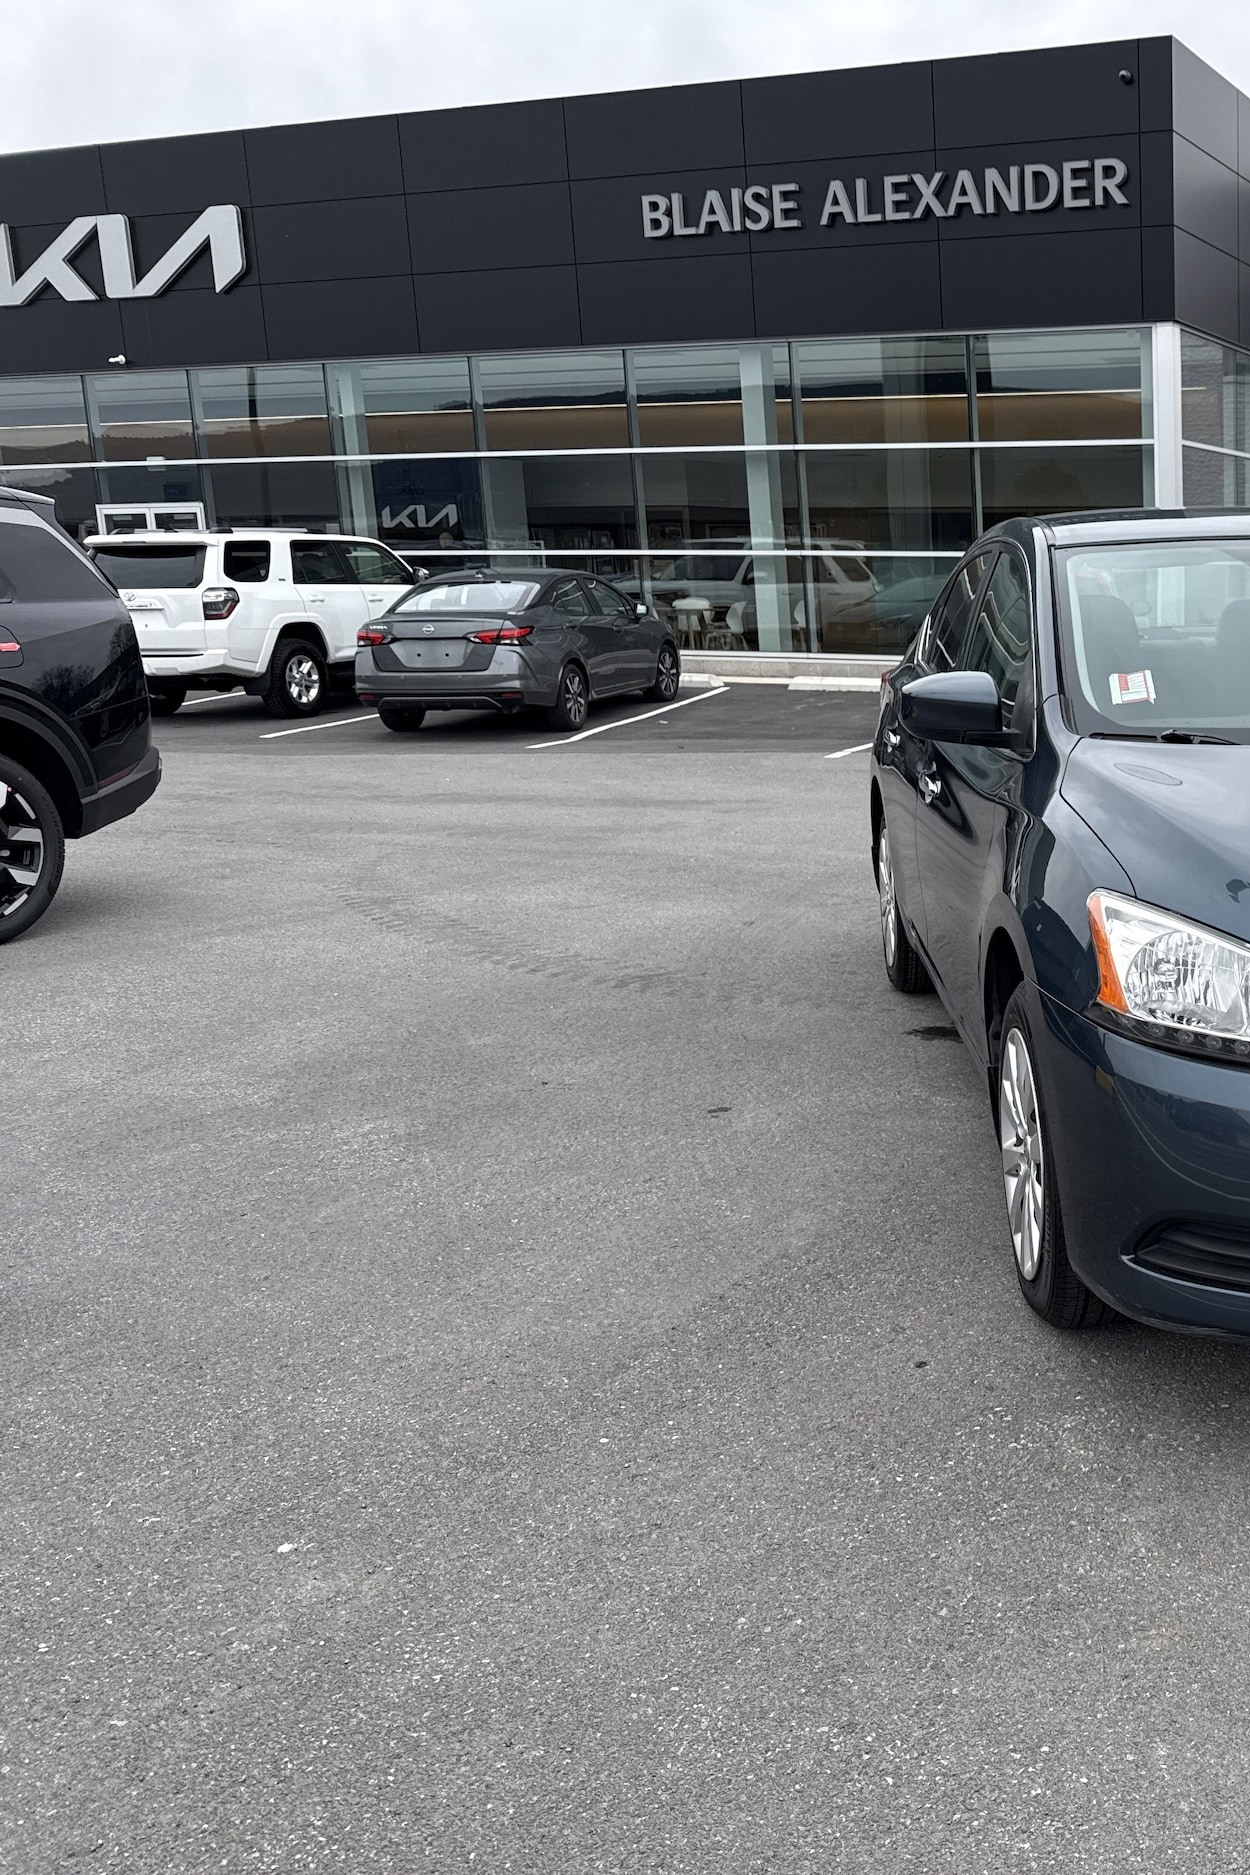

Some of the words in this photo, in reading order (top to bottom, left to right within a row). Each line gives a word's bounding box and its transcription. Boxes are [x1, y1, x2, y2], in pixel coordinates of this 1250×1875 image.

[641, 182, 800, 238] BLAISE
[819, 157, 1129, 226] ALEXANDER
[381, 504, 458, 528] KIA
